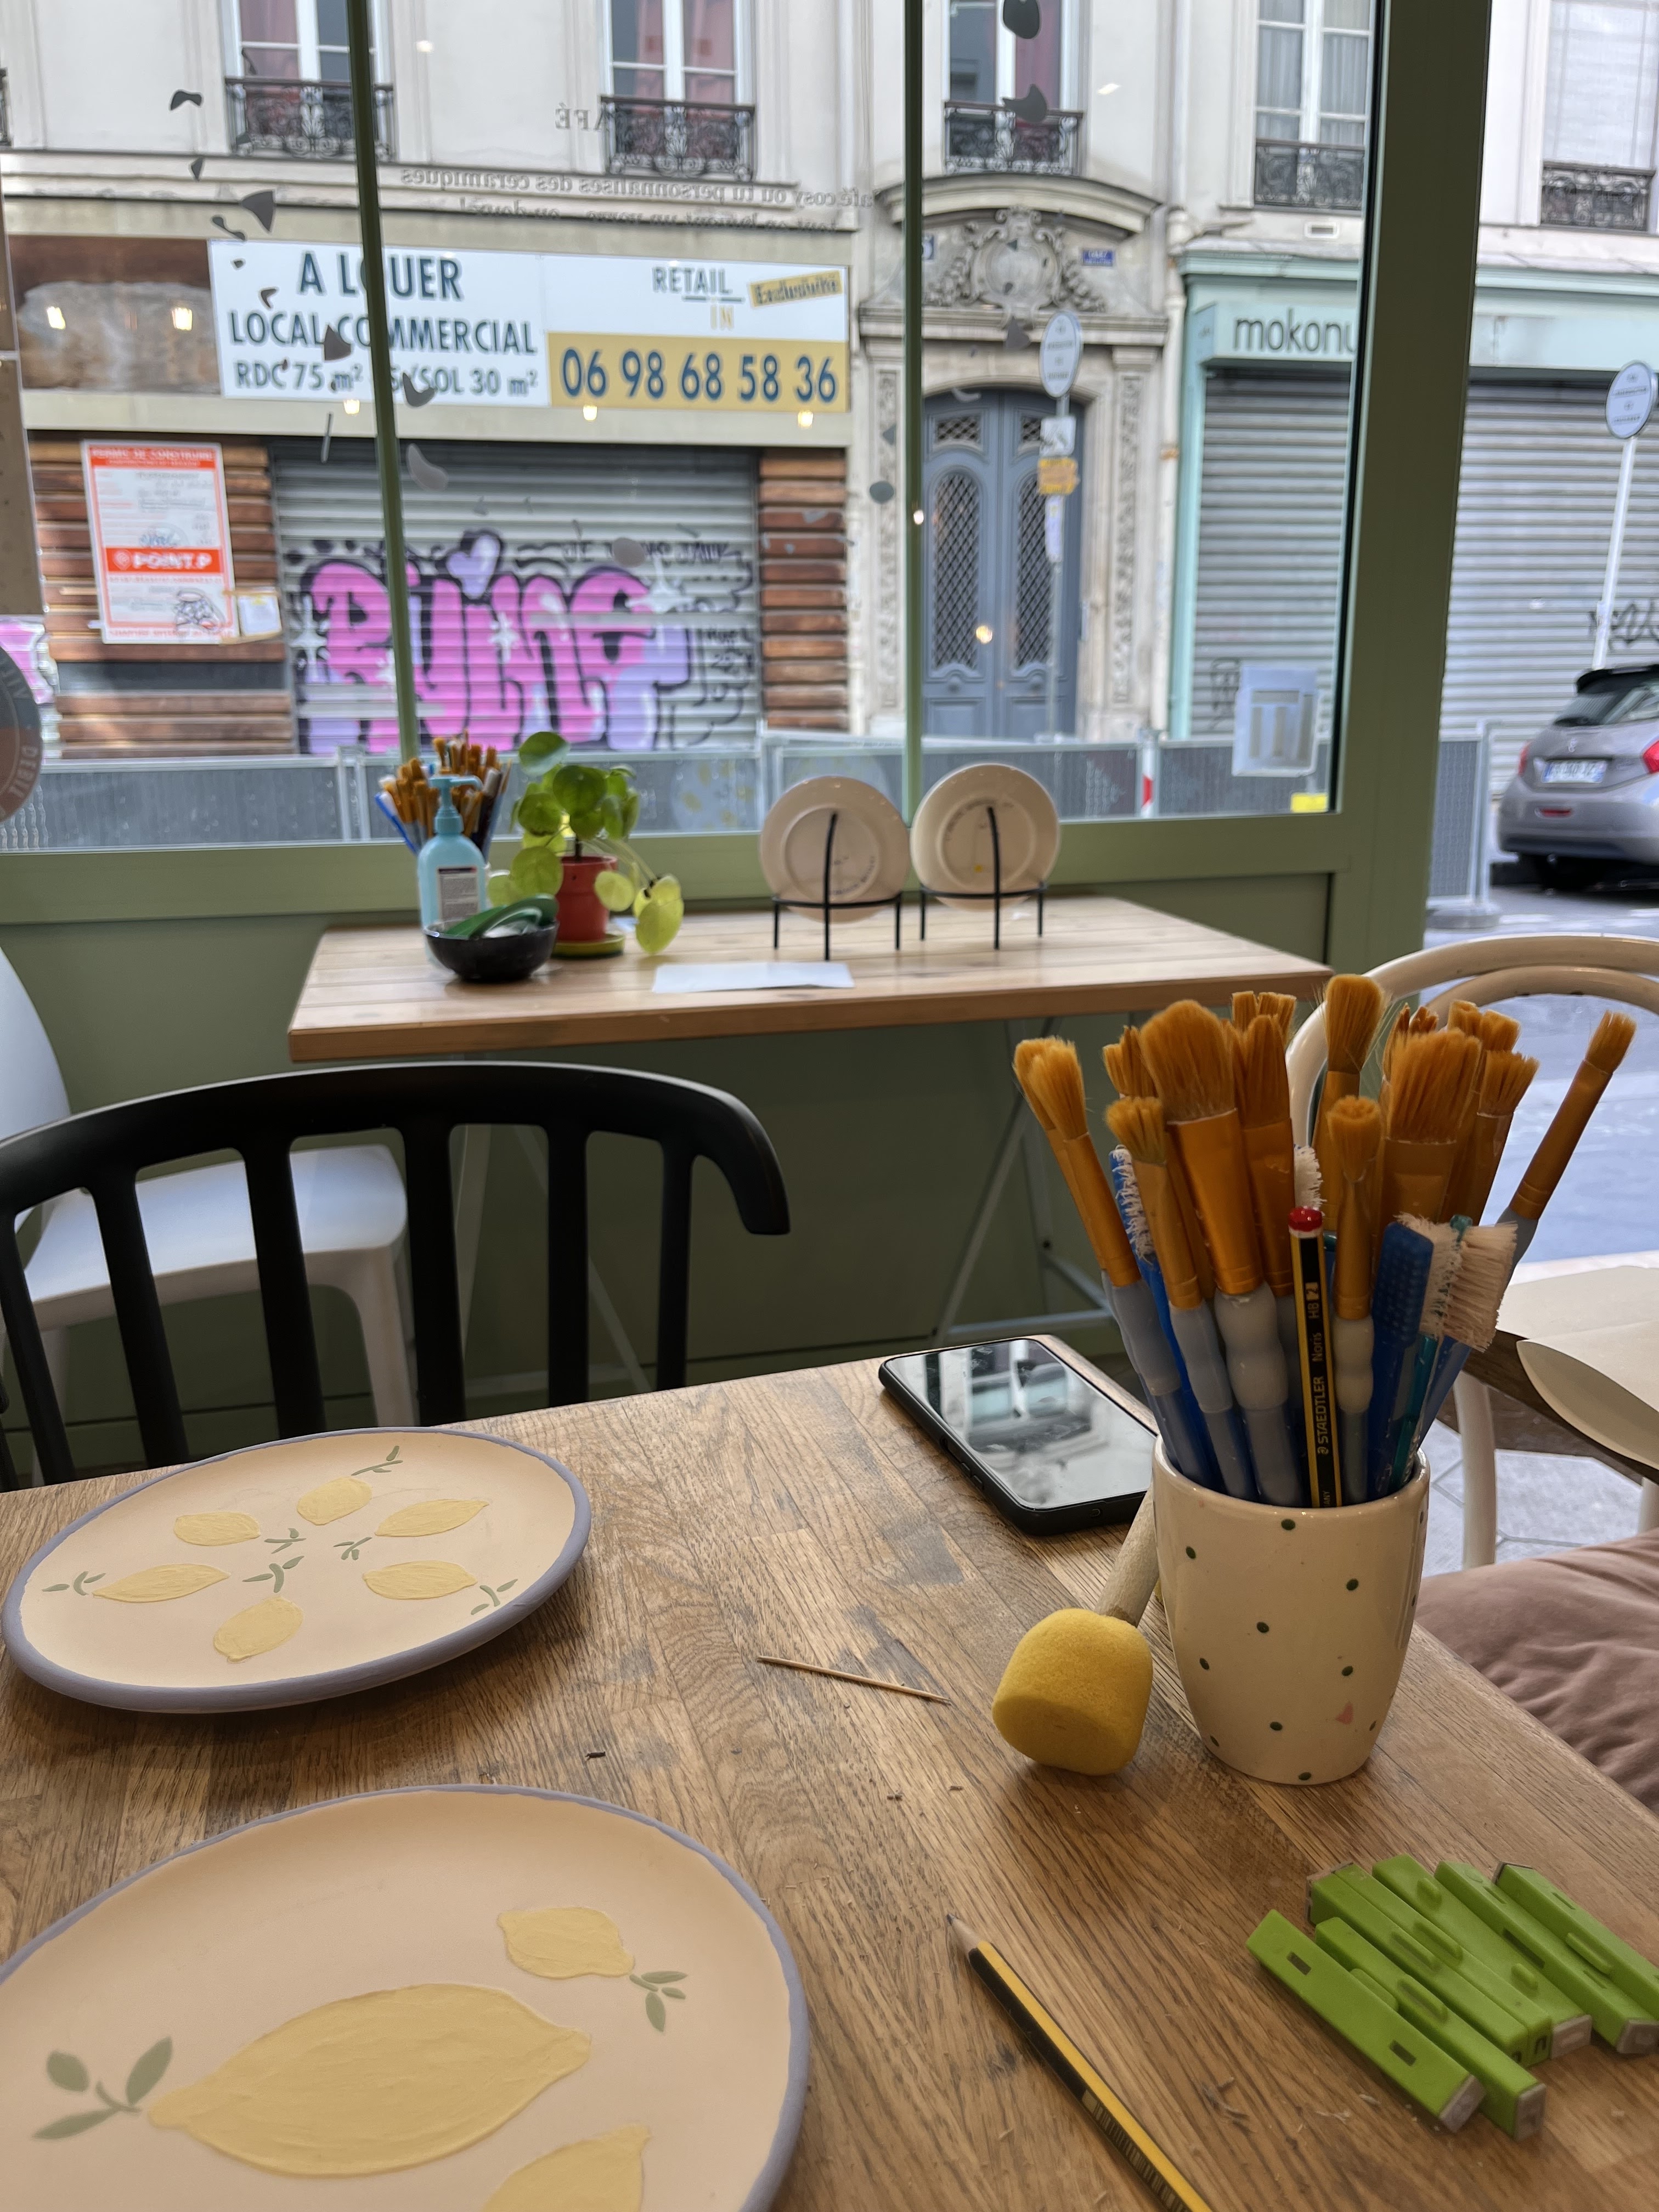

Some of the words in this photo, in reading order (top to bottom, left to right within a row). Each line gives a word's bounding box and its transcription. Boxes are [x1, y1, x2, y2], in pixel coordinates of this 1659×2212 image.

[301, 253, 323, 292] A
[340, 254, 461, 300] LUER
[652, 267, 733, 295] RETAIL
[231, 312, 326, 346] LOCAL
[711, 305, 735, 330] IN
[237, 362, 285, 387] RDC
[294, 363, 322, 388] 75
[469, 369, 501, 394] 30
[510, 370, 538, 396] m²
[562, 348, 606, 397] 06
[622, 350, 664, 399] 98
[681, 353, 723, 401] 68
[739, 354, 779, 403] 58
[796, 356, 837, 404] 36
[1306, 1282, 1320, 1300] 2
[1307, 1301, 1321, 1320] HB
[1311, 1331, 1324, 1363] Noris
[1313, 1375, 1330, 1444] STAEDTLER
